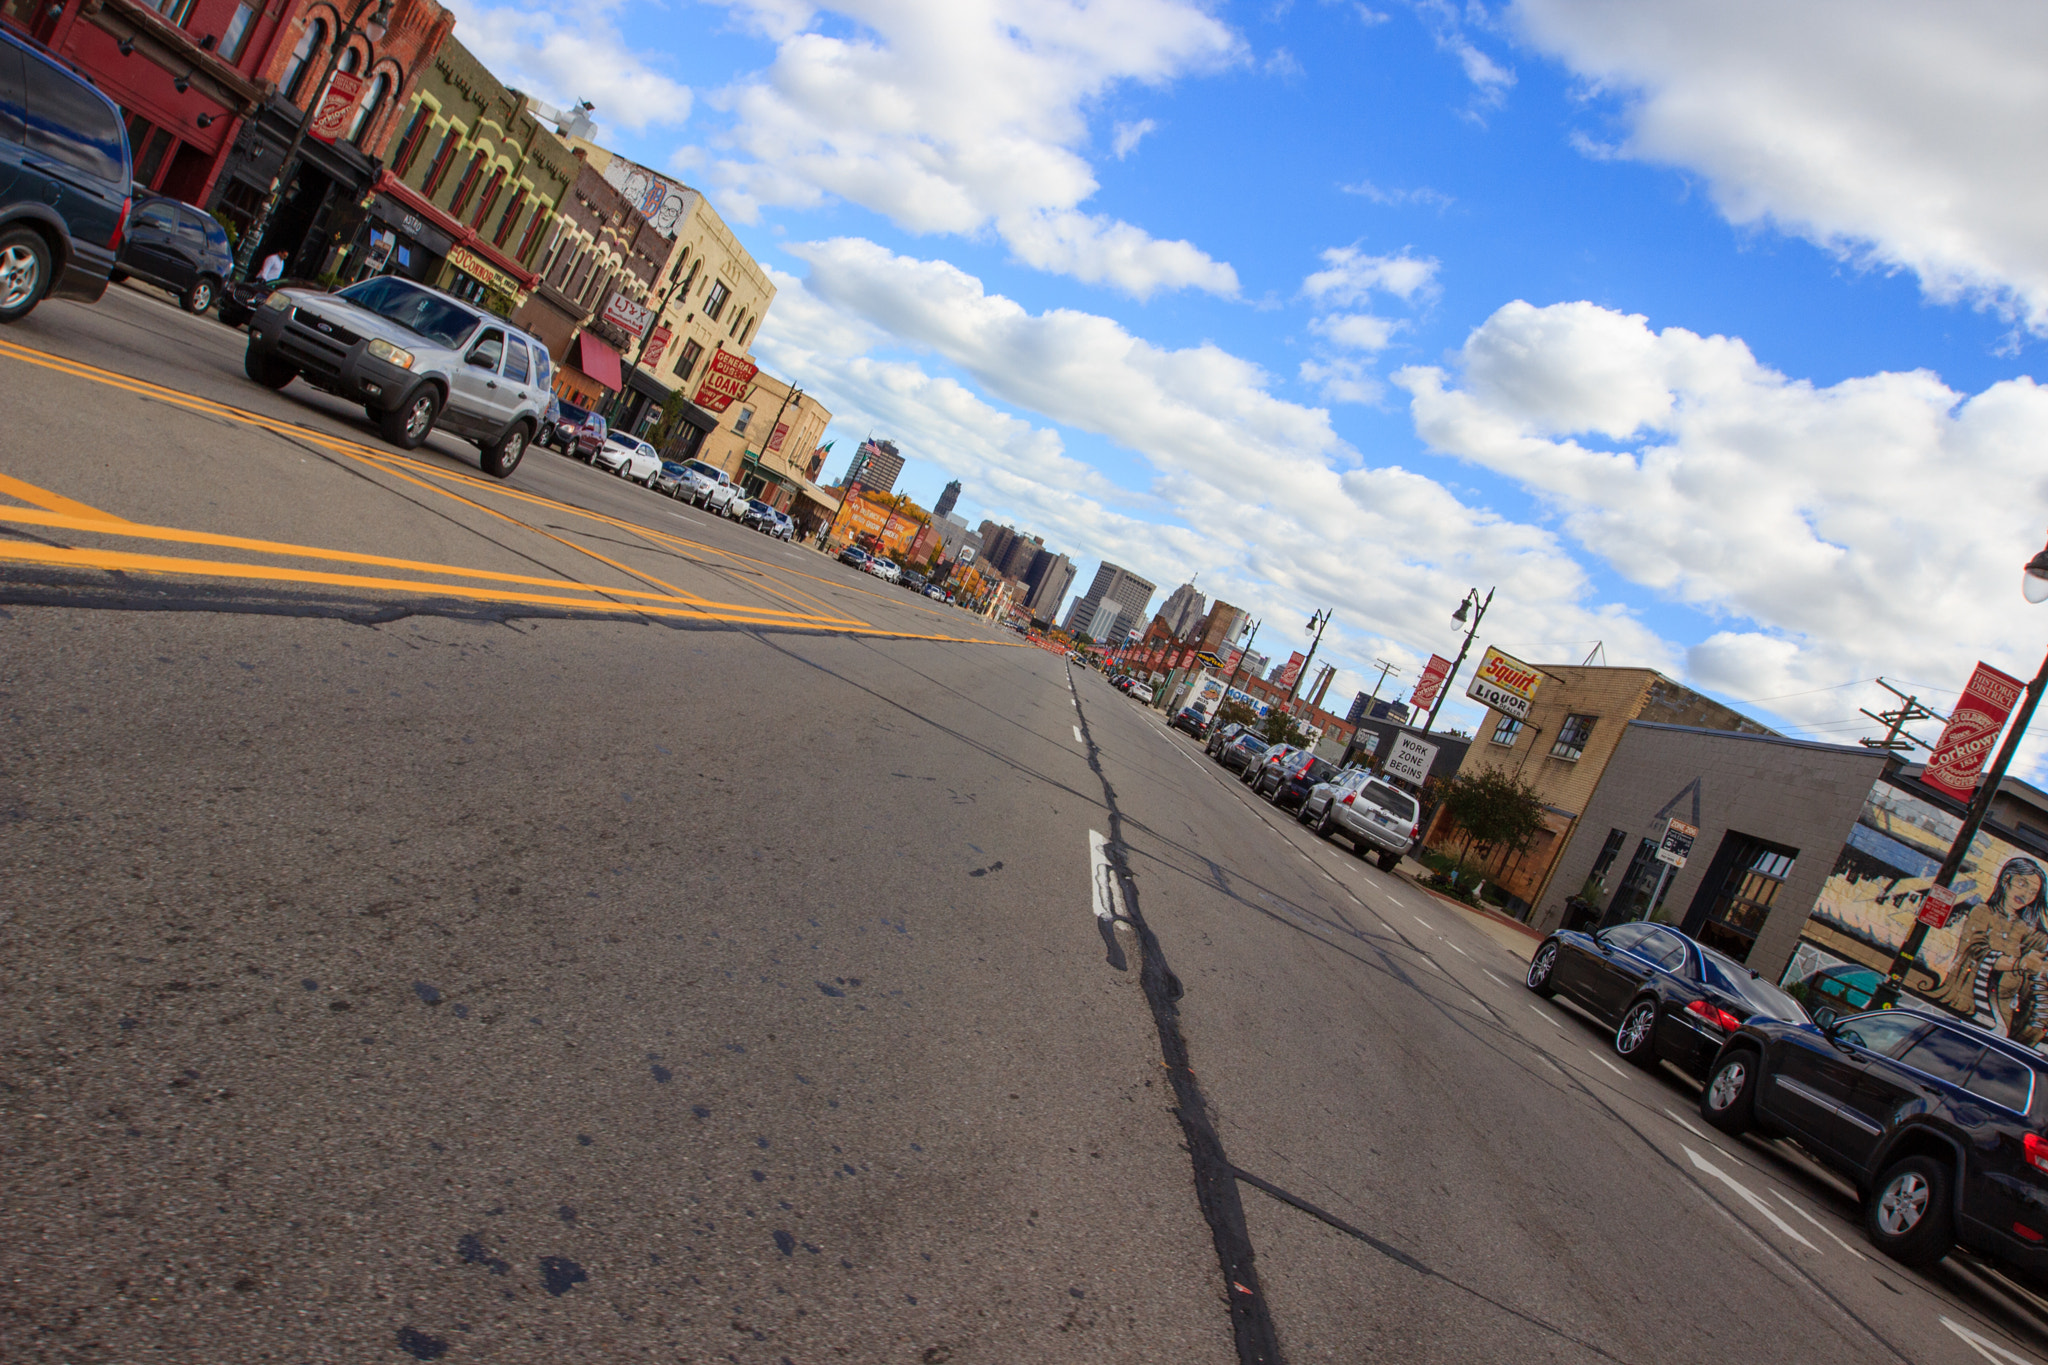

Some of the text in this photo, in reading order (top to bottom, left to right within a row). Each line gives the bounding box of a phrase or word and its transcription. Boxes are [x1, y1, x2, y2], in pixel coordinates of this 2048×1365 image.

[312, 105, 351, 128] Corktown
[403, 214, 422, 232] ASTRO
[717, 352, 754, 374] GENERAL
[717, 362, 749, 380] PUBLIC
[708, 372, 748, 399] LOANS
[881, 528, 899, 540] ONDER
[1195, 652, 1225, 669] OODYEAR
[1486, 656, 1537, 692] Squirt
[1971, 681, 2013, 707] DISTRICT
[1975, 673, 2018, 700] HISTORIC
[1475, 684, 1527, 712] LIQUOR
[1499, 703, 1521, 717] DEALER
[1949, 729, 1970, 741] Since
[1402, 739, 1428, 756] WORK
[1927, 731, 2000, 768] Corktown
[1398, 750, 1424, 767] ZONE
[1960, 756, 1978, 769] 1834
[1389, 759, 1422, 780] BEGINS
[1670, 820, 1685, 831] ZONE
